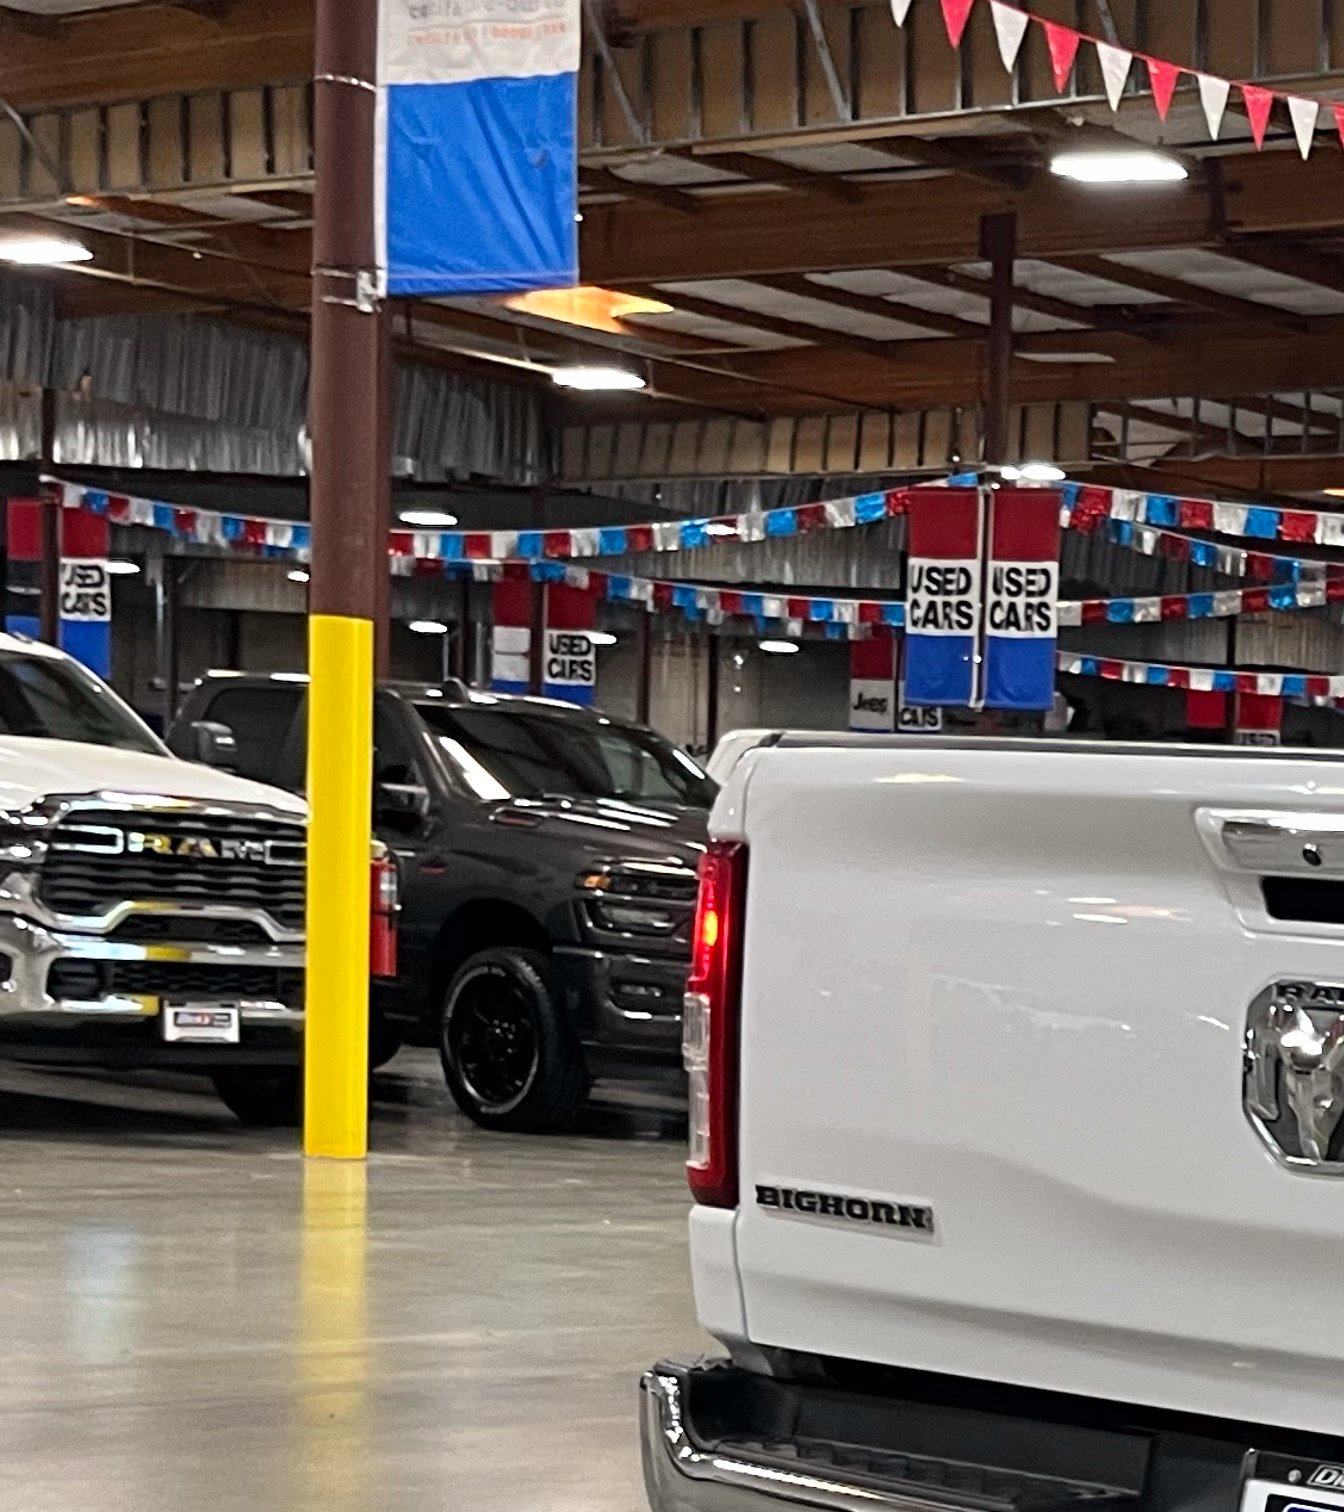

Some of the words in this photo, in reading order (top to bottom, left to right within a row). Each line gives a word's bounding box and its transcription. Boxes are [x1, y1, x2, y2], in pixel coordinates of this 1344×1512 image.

[911, 565, 972, 596] USED
[992, 567, 1051, 597] USED
[910, 598, 973, 630] CARS
[990, 600, 1051, 631] CARS
[128, 832, 264, 861] RAM
